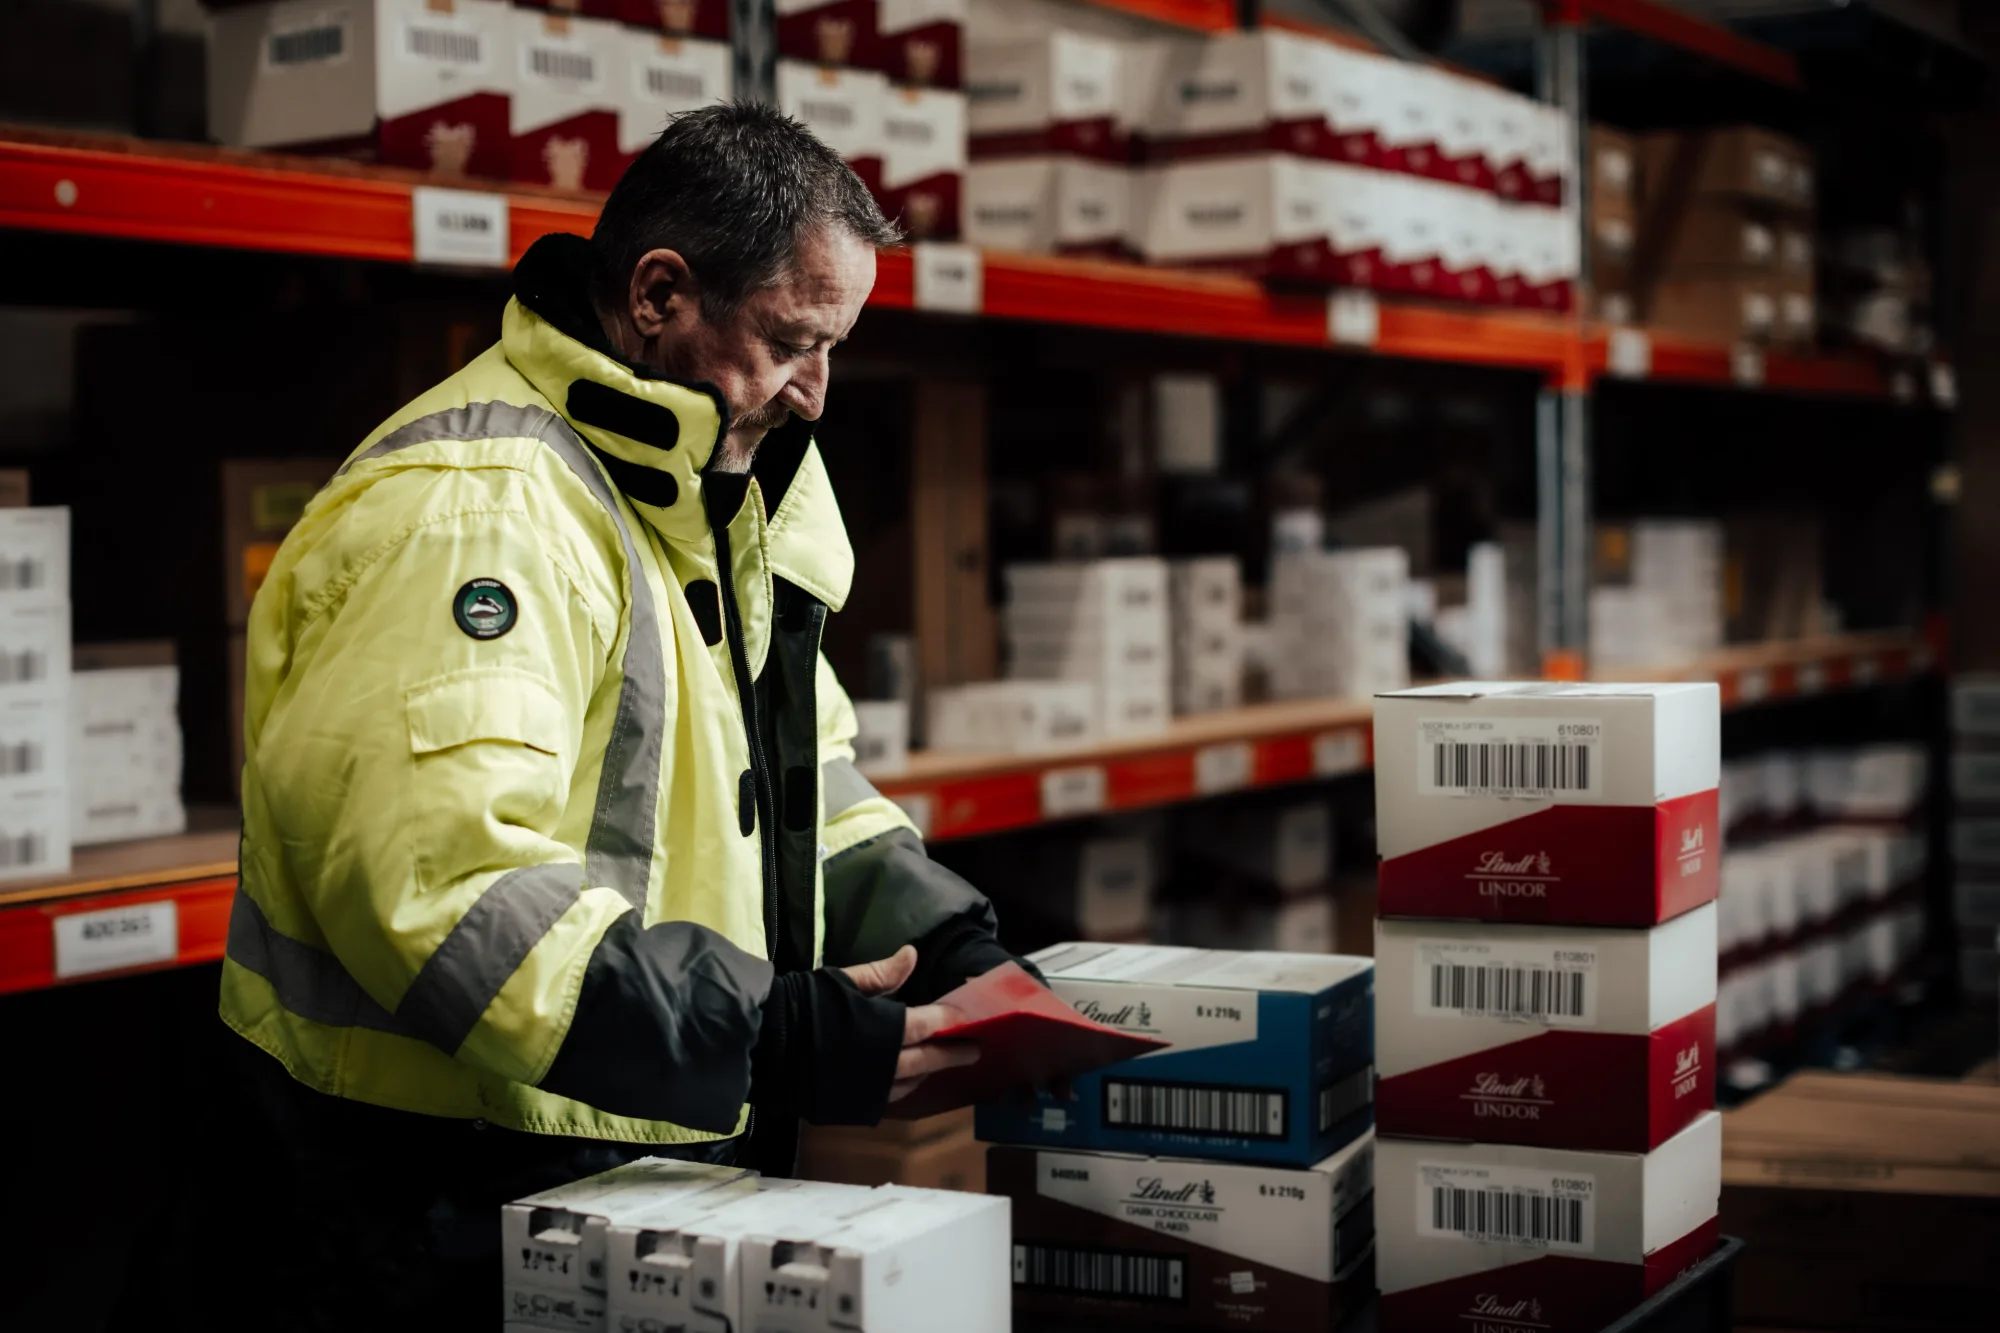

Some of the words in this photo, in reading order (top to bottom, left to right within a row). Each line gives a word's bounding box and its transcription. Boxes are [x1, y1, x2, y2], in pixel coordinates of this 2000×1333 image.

[1557, 724, 1600, 736] 610801
[1475, 851, 1537, 875] Lindt
[1479, 881, 1546, 897] LINDOR
[1553, 950, 1595, 964] 610801
[1073, 1000, 1135, 1024] Lindt
[1206, 1008, 1212, 1018] x
[1214, 1006, 1241, 1021] 210g
[1470, 1072, 1530, 1095] Lindt
[1474, 1102, 1540, 1119] LINDOR
[1130, 1177, 1198, 1201] Lindt
[1259, 1184, 1267, 1196] 6
[1269, 1187, 1275, 1197] x
[1279, 1185, 1305, 1201] 210g
[1552, 1178, 1592, 1191] 610801
[1126, 1206, 1155, 1218] DARK
[1156, 1208, 1218, 1222] CHOCOLATE
[1155, 1220, 1190, 1232] FLAKES
[1468, 1293, 1528, 1318] Lindt
